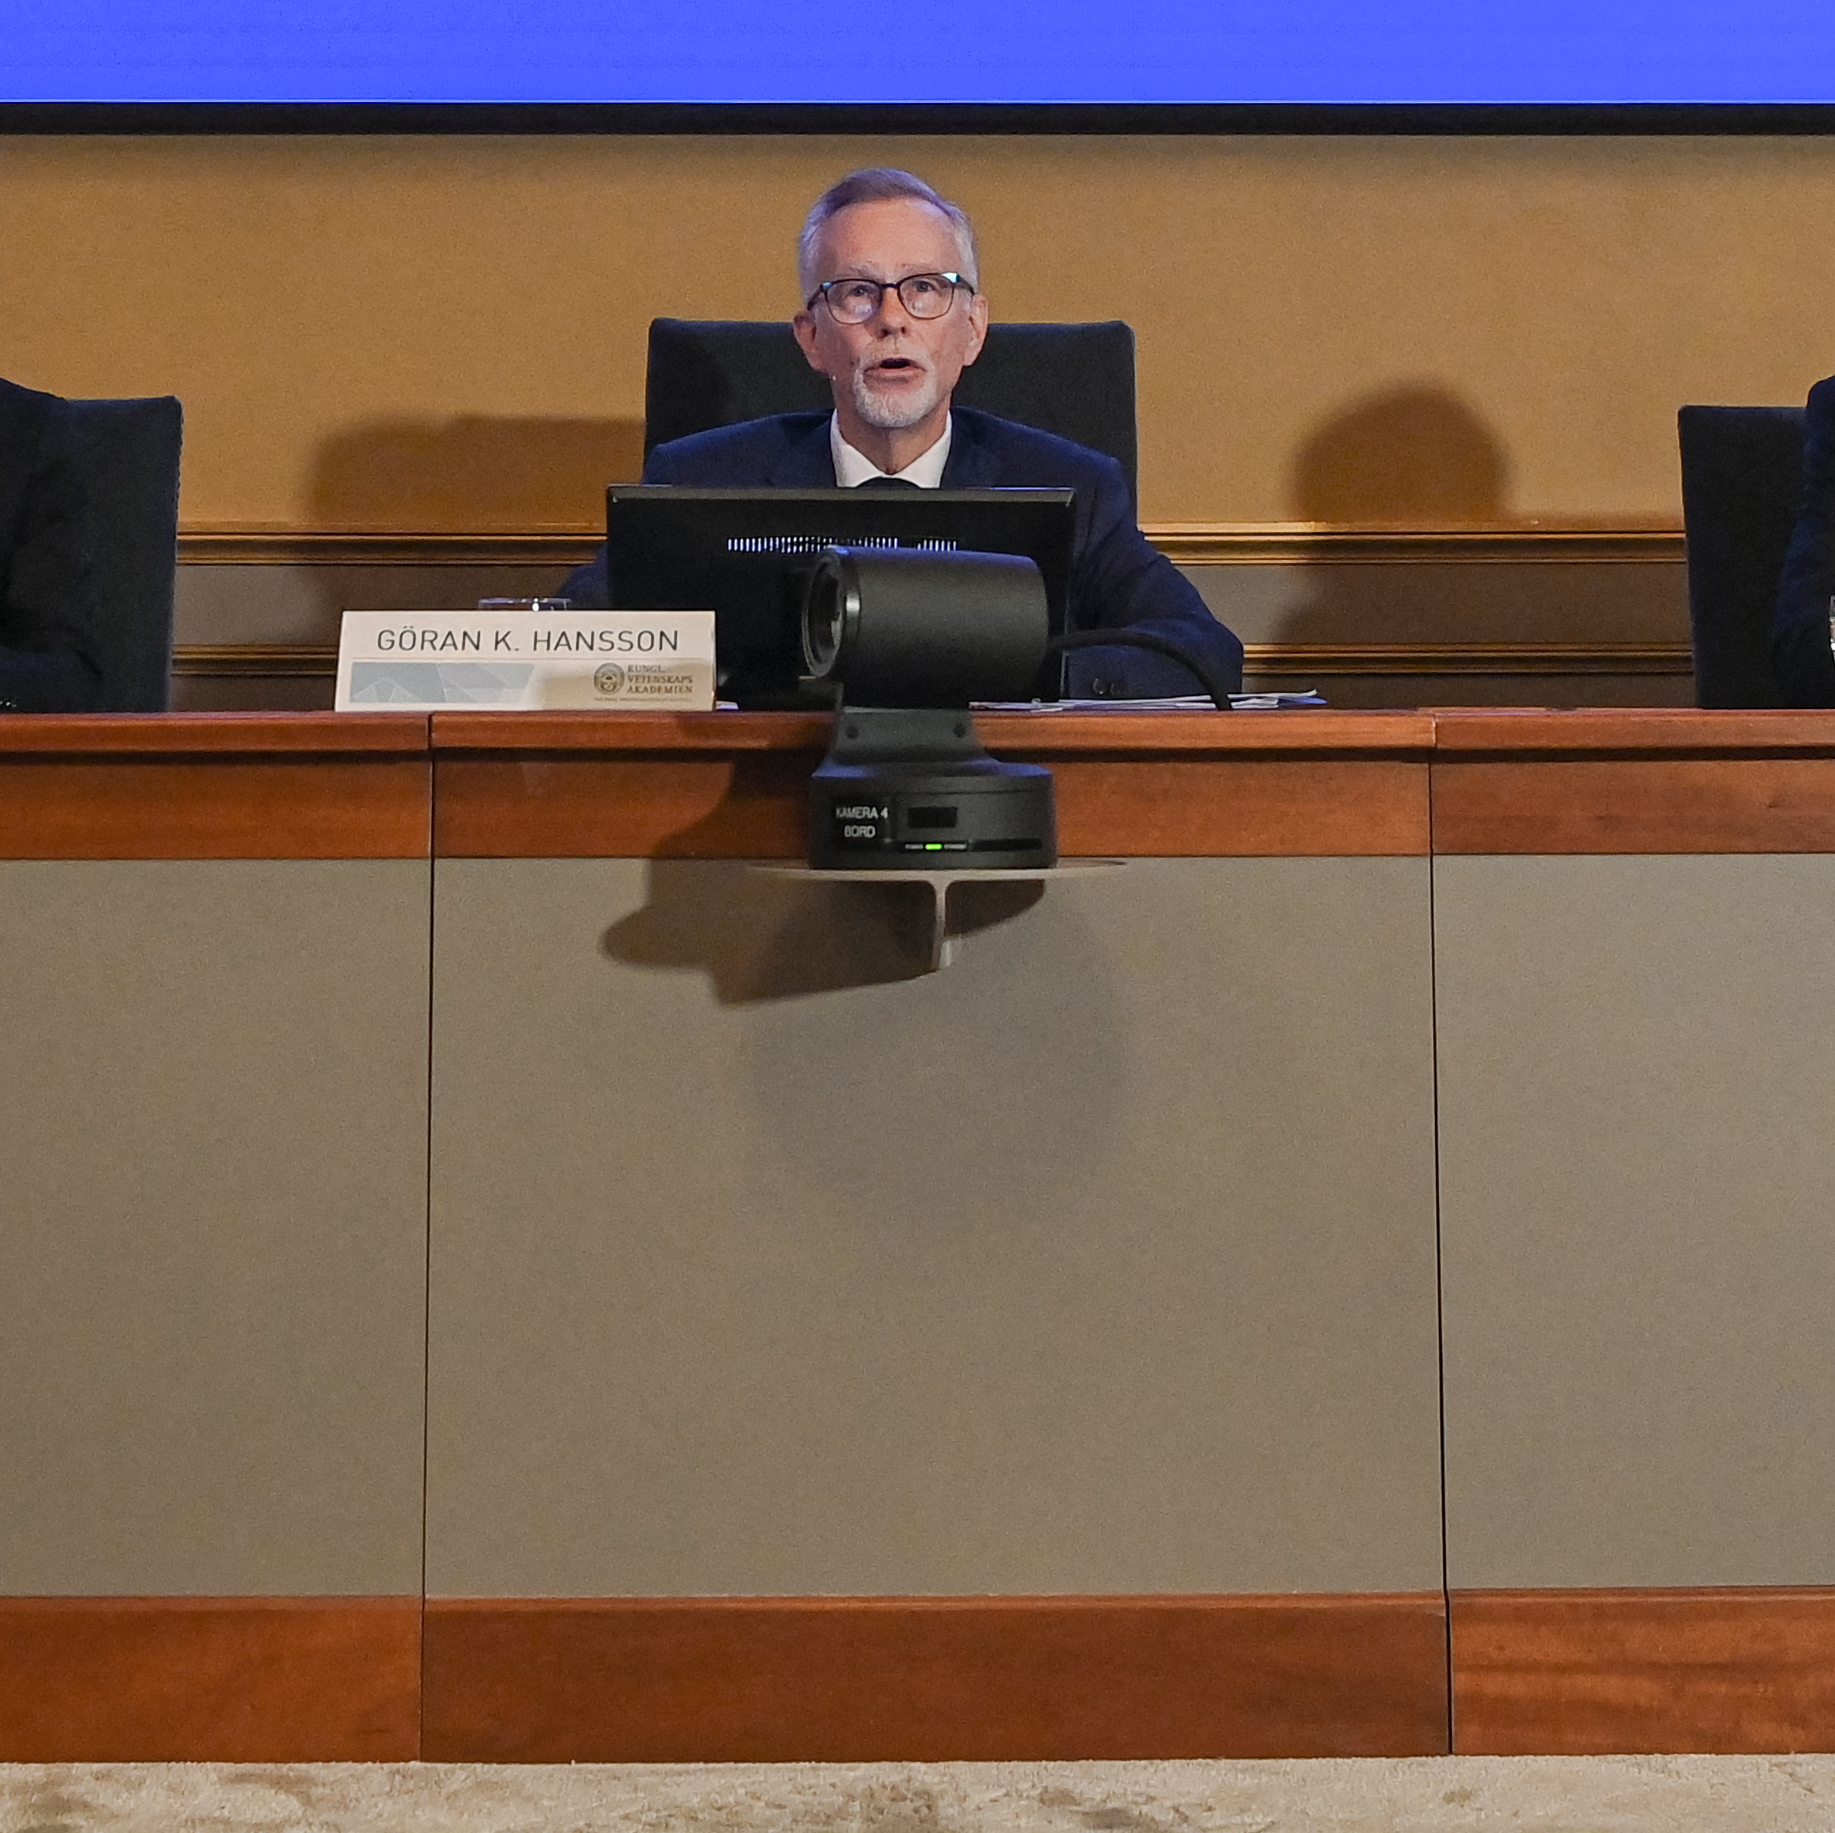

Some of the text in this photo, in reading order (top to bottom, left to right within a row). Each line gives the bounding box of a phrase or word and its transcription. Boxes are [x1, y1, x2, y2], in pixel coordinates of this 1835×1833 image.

[376, 624, 678, 653] GÖRAN K. HANSSON
[836, 806, 888, 818] KAMERA 4
